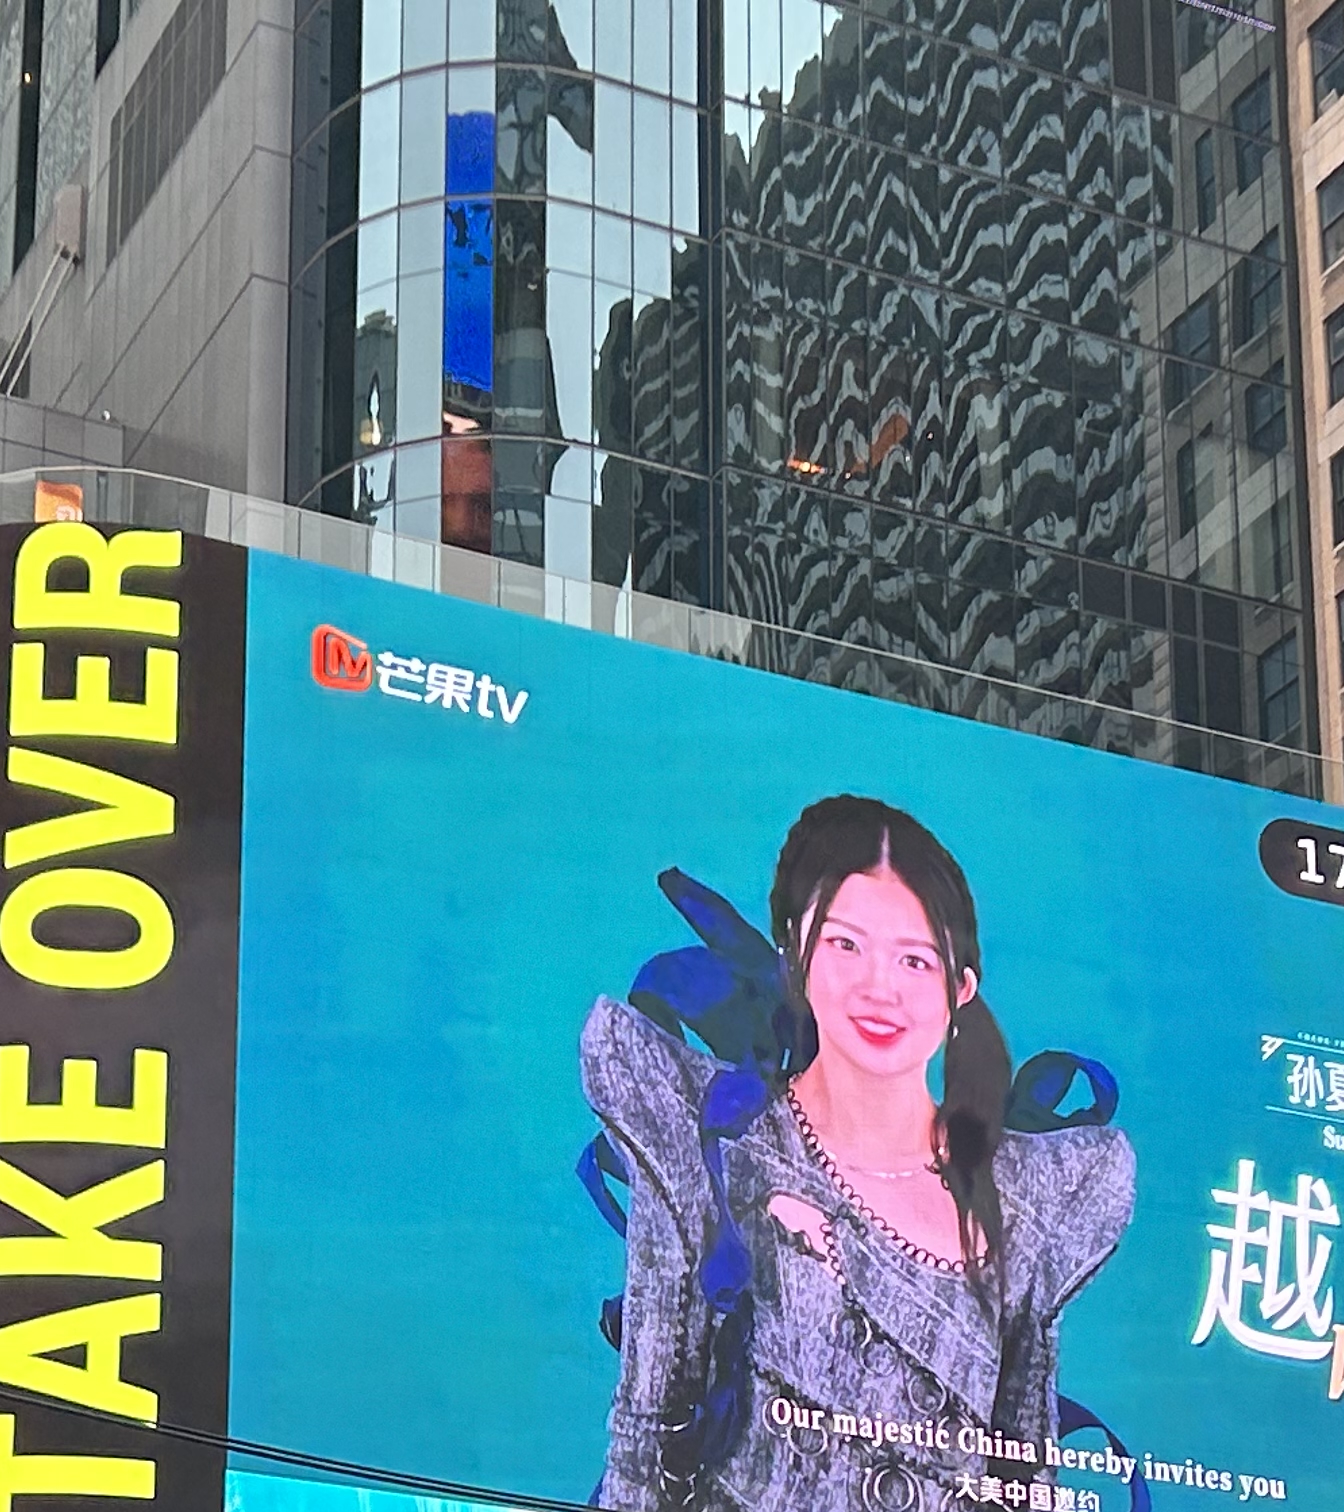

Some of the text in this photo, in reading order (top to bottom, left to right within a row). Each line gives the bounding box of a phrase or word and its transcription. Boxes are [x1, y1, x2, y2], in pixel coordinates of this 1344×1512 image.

[376, 651, 529, 724] 芒果tv
[770, 1398, 1287, 1501] Our majestic China hereby invites you
